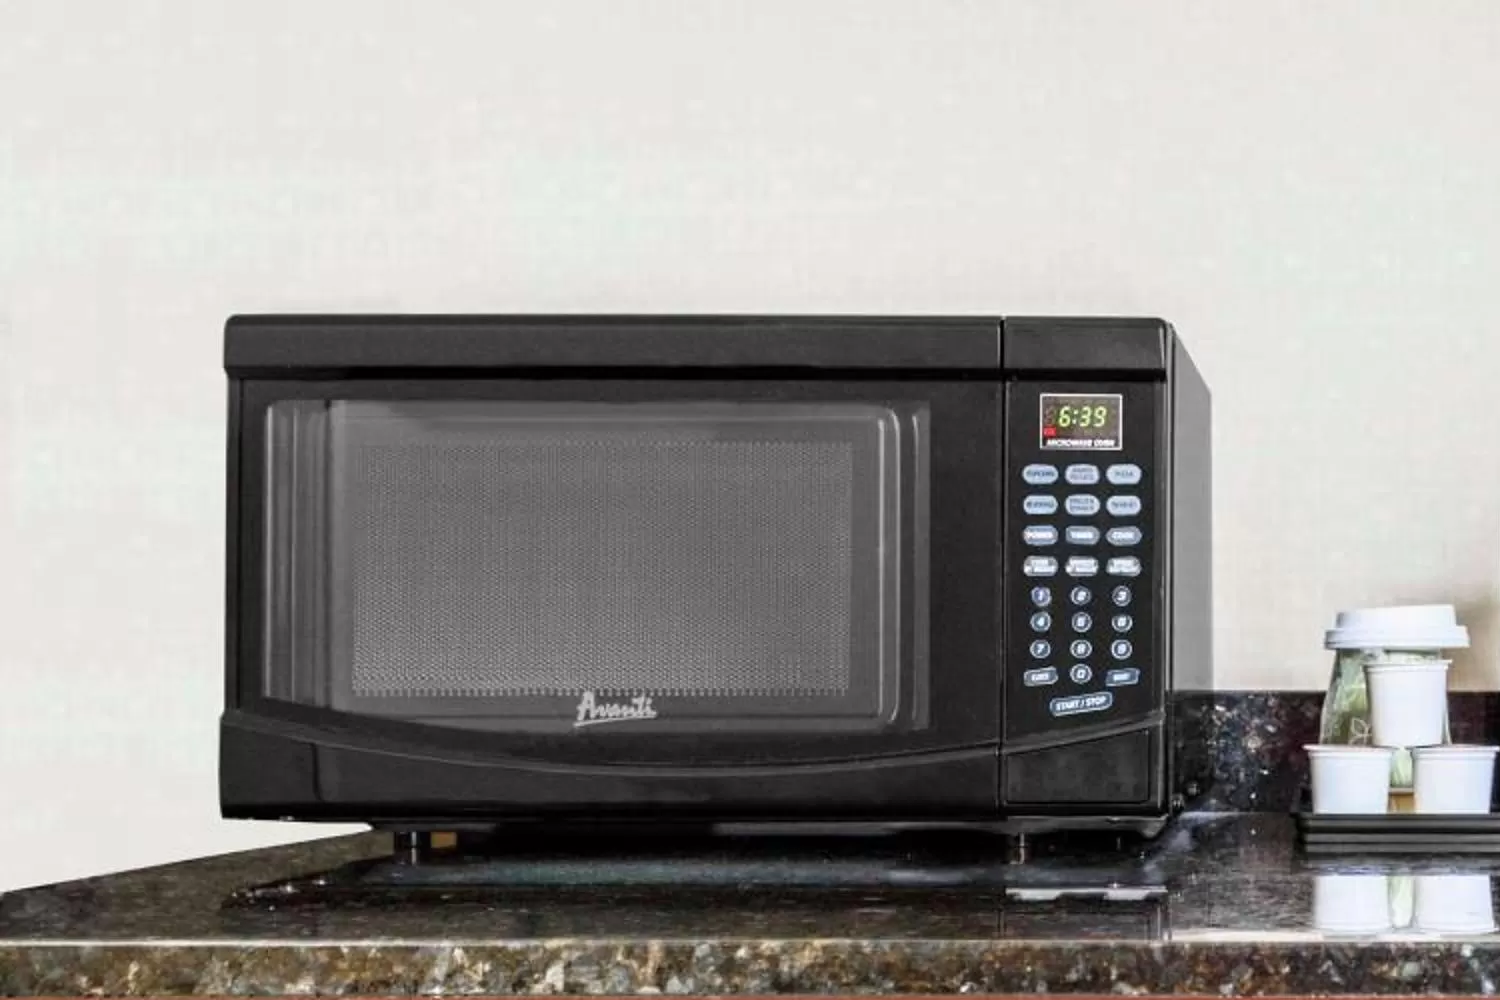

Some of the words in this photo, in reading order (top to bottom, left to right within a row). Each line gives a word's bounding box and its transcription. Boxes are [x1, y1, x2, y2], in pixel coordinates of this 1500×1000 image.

[1058, 405, 1107, 428] 6:39
[1046, 438, 1092, 447] MICROWAVE
[1094, 438, 1115, 447] OVEN
[574, 689, 657, 725] Avanti
[1055, 700, 1079, 711] START
[1085, 696, 1107, 708] STOP
